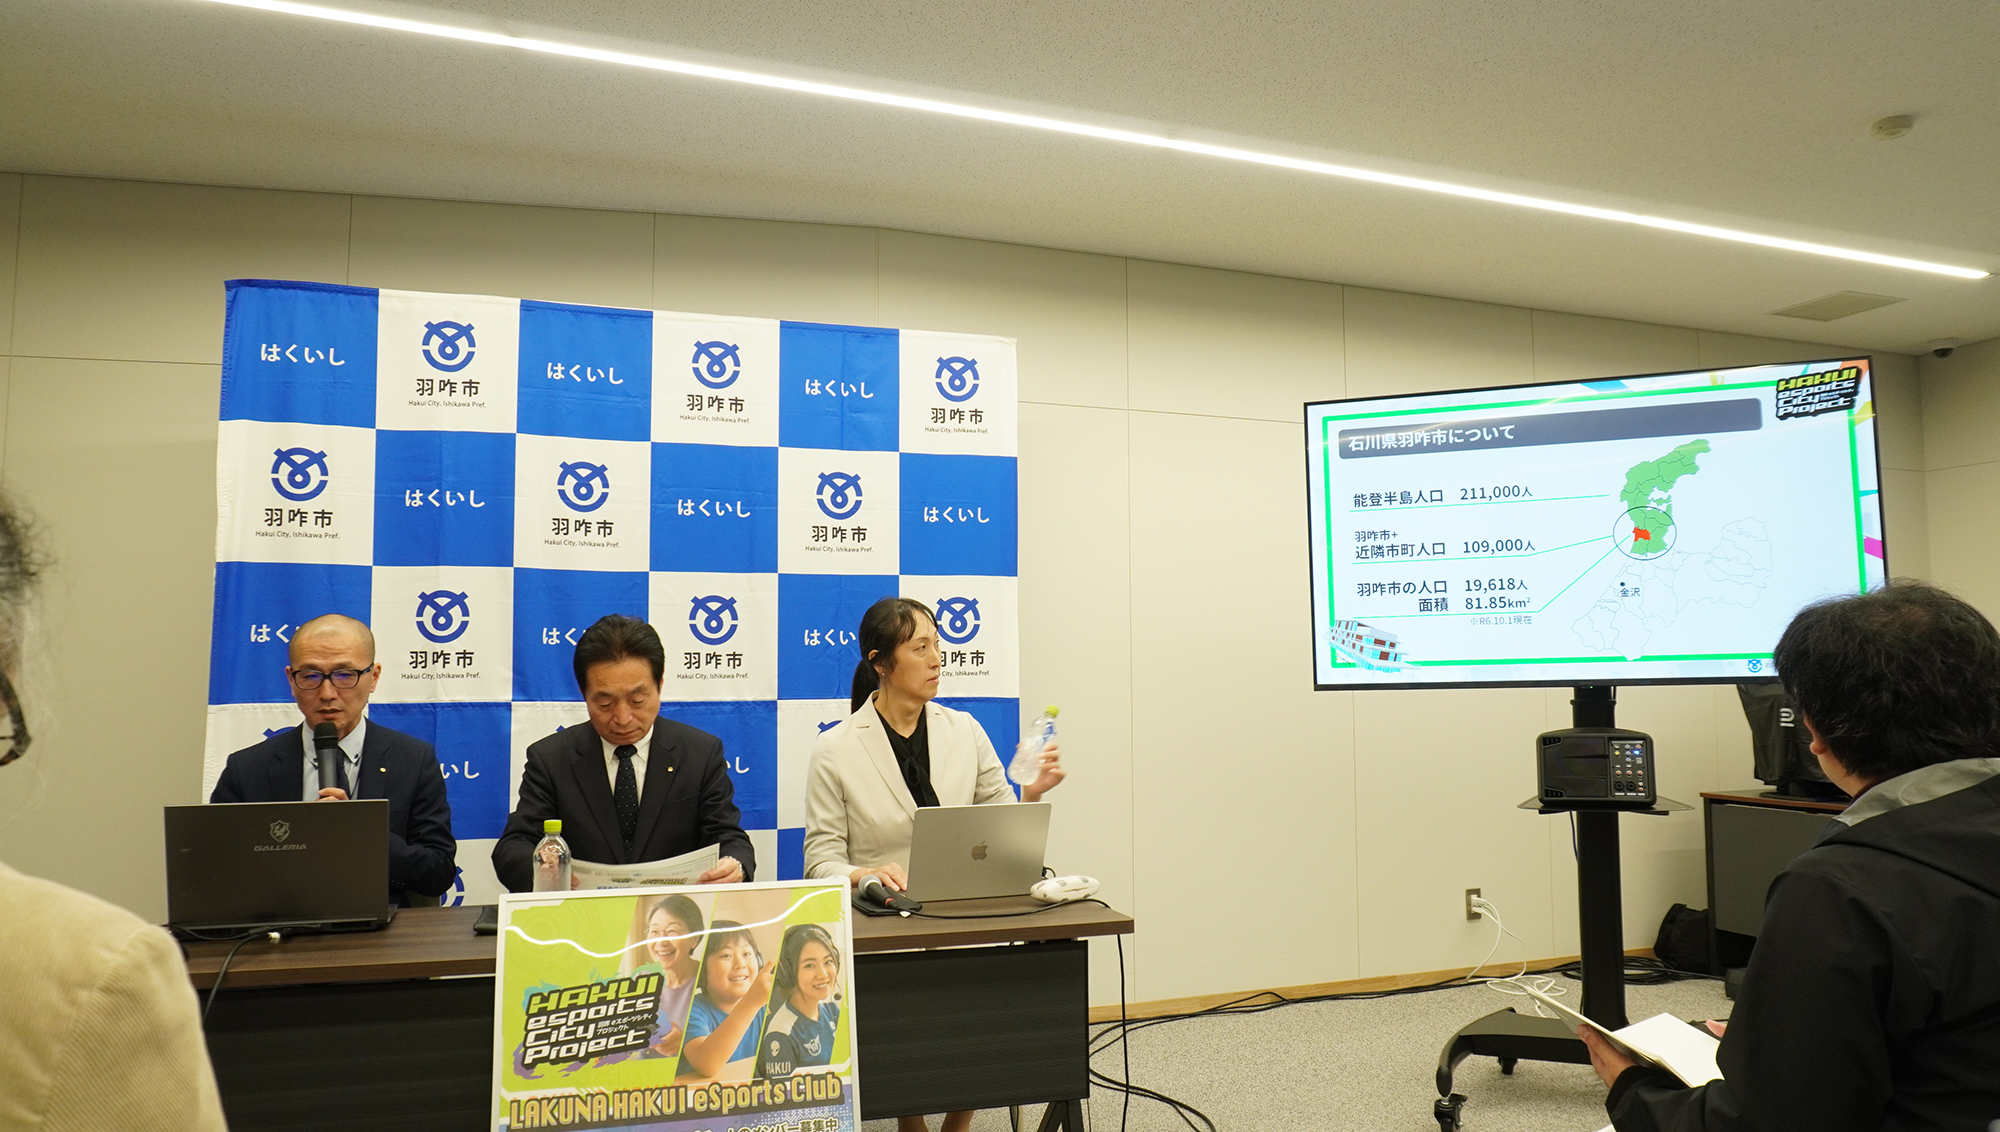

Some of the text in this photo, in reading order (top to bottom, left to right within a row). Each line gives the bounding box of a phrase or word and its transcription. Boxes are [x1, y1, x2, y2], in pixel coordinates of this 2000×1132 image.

[260, 343, 346, 366] はくいし
[547, 362, 624, 385] はくいし
[1778, 368, 1858, 391] HAKUI
[416, 379, 480, 397] 羽咋市
[805, 379, 874, 400] はくいし
[1777, 379, 1856, 398] esports
[687, 394, 745, 414] 羽咋市
[1777, 394, 1820, 408] City
[931, 408, 984, 425] 羽咋市
[1348, 425, 1516, 451] 石川県羽咋市について
[405, 489, 486, 508] はくいし
[1353, 485, 1533, 508] 能登半島人口 211,000人
[264, 508, 333, 528] 羽咋市
[678, 499, 752, 518] はくいし
[923, 505, 990, 524] はくいし
[551, 518, 614, 538] 羽咋市
[811, 526, 867, 543] 羽咋市
[1355, 538, 1536, 559] 近隣市町人口 109,000人
[1356, 578, 1528, 597] 羽咋市の人口 19,618人
[1620, 587, 1640, 597] 金沢
[1418, 597, 1449, 613] 面積
[250, 624, 300, 643] はく
[542, 627, 587, 646] はく
[804, 629, 857, 646] はくい
[409, 650, 474, 669] 羽咋市
[684, 651, 743, 669] 羽咋市
[440, 761, 480, 779] いし
[254, 843, 307, 852] GALLERIA
[528, 975, 659, 1014] HAKUI
[527, 996, 655, 1030] esports
[525, 1023, 596, 1047] City
[596, 1024, 629, 1035] プロジェクト
[523, 1029, 646, 1065] Project
[766, 1061, 791, 1074] HAKUI
[510, 1074, 841, 1130] LAKUNA HAKUI eSports Club
